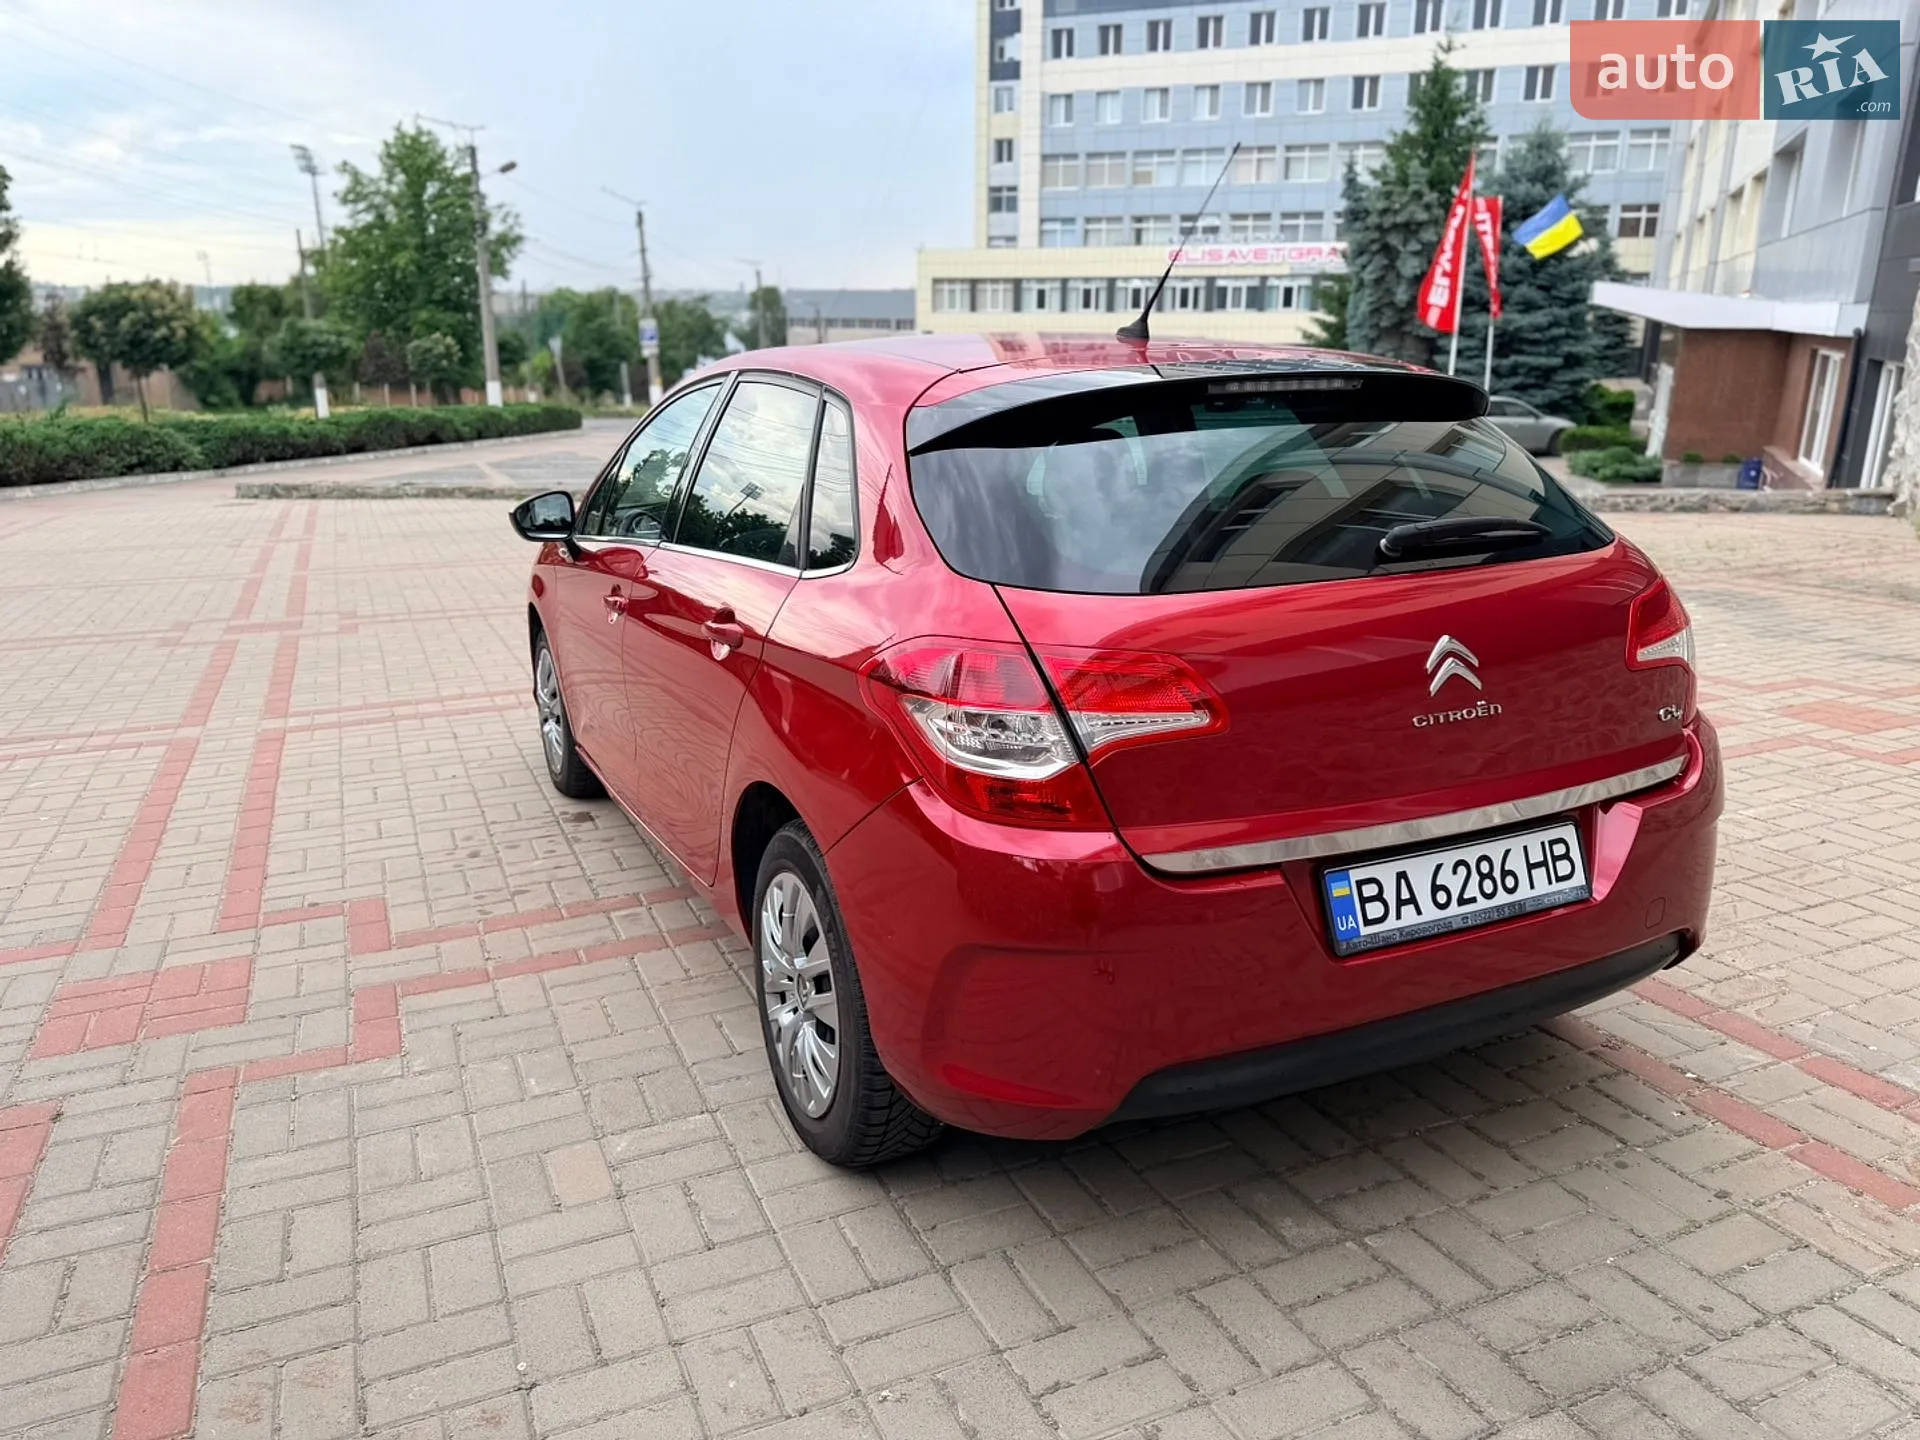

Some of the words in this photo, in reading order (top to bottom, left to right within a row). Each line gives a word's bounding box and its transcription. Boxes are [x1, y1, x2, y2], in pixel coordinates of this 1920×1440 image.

[1169, 246, 1350, 263] ELISAVETGRA
[1355, 870, 1423, 927] BA
[1430, 848, 1519, 910] 6286
[1523, 837, 1576, 890] HB
[1337, 914, 1358, 931] UA
